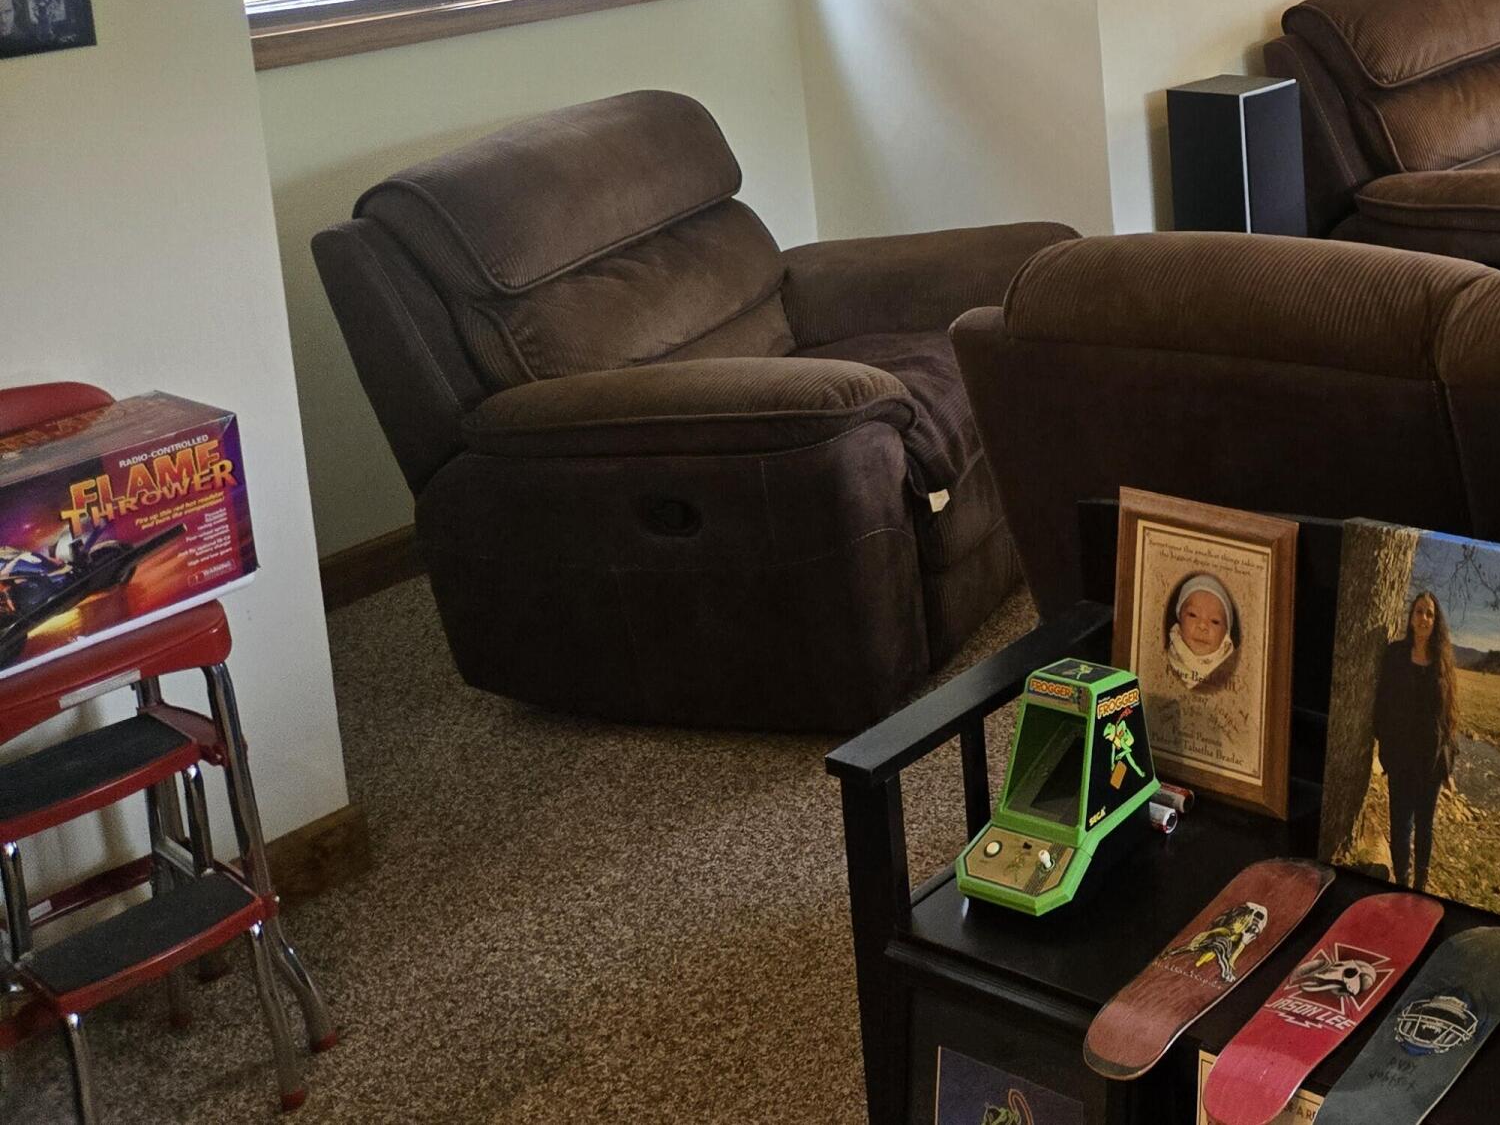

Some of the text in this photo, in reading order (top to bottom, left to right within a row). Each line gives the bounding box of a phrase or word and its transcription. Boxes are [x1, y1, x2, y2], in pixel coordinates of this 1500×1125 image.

[119, 434, 209, 468] RADIO-CONTROLLED
[69, 439, 220, 512] FLAME
[60, 459, 238, 538] THROWER
[1030, 679, 1074, 698] FROGGER
[1097, 688, 1139, 719] FROGGER
[1264, 997, 1357, 1030] JASON LEE
